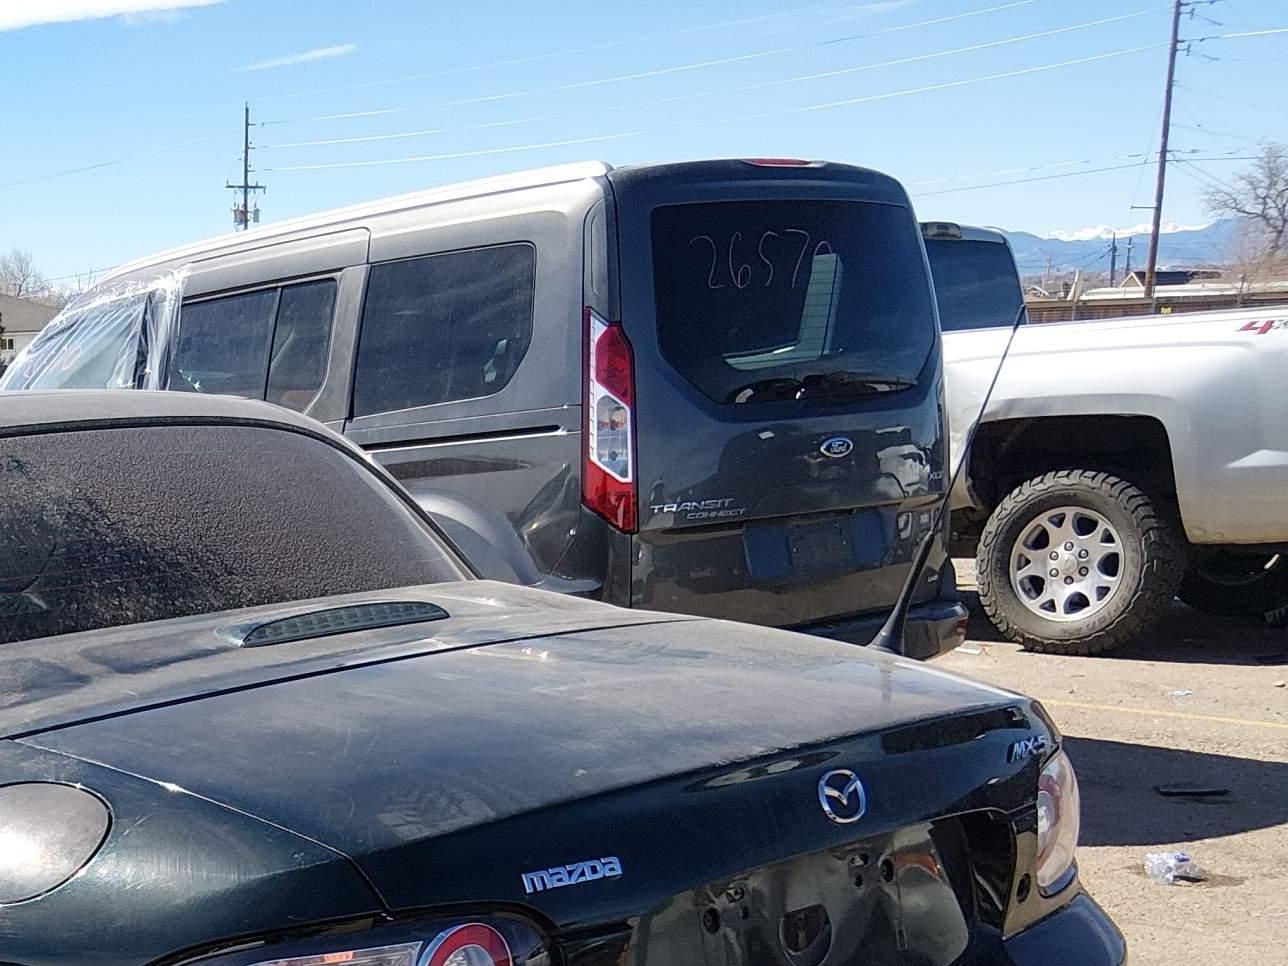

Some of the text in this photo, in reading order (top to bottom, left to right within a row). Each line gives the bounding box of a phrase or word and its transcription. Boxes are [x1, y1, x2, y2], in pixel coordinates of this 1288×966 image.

[689, 228, 833, 289] 2657
[650, 497, 735, 514] TRANSIT
[686, 507, 747, 520] CONNECT
[1011, 734, 1049, 763] MX-5
